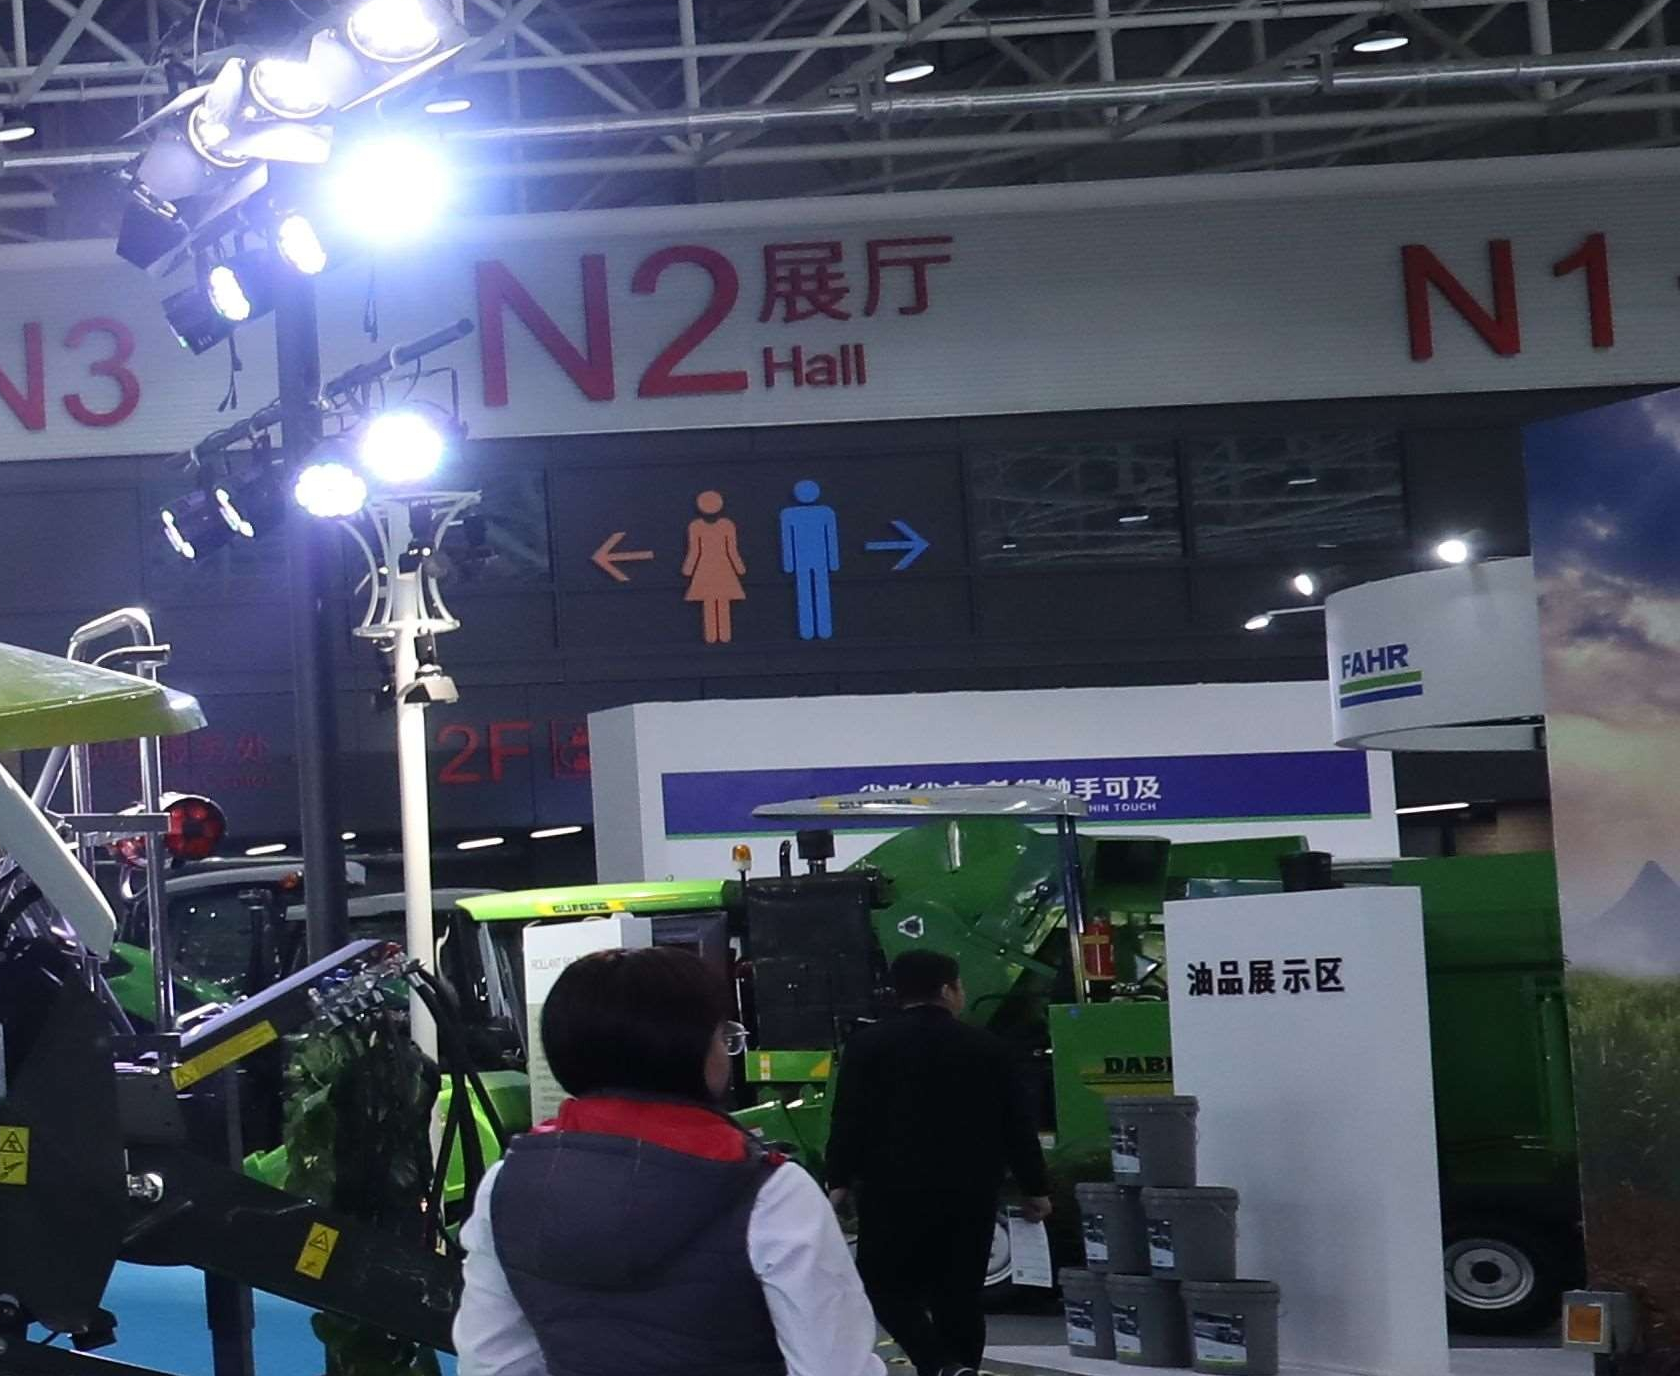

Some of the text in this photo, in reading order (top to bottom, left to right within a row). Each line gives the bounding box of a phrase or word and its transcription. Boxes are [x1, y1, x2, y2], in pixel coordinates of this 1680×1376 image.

[758, 236, 954, 324] 展厅
[1401, 232, 1614, 362] N1
[476, 244, 748, 407] N2
[763, 343, 866, 388] Hall
[1341, 644, 1409, 679] FAHR
[435, 721, 532, 785] 2F
[1088, 802, 1157, 813] HIN TOUCH
[1187, 958, 1345, 996] 油品展示区
